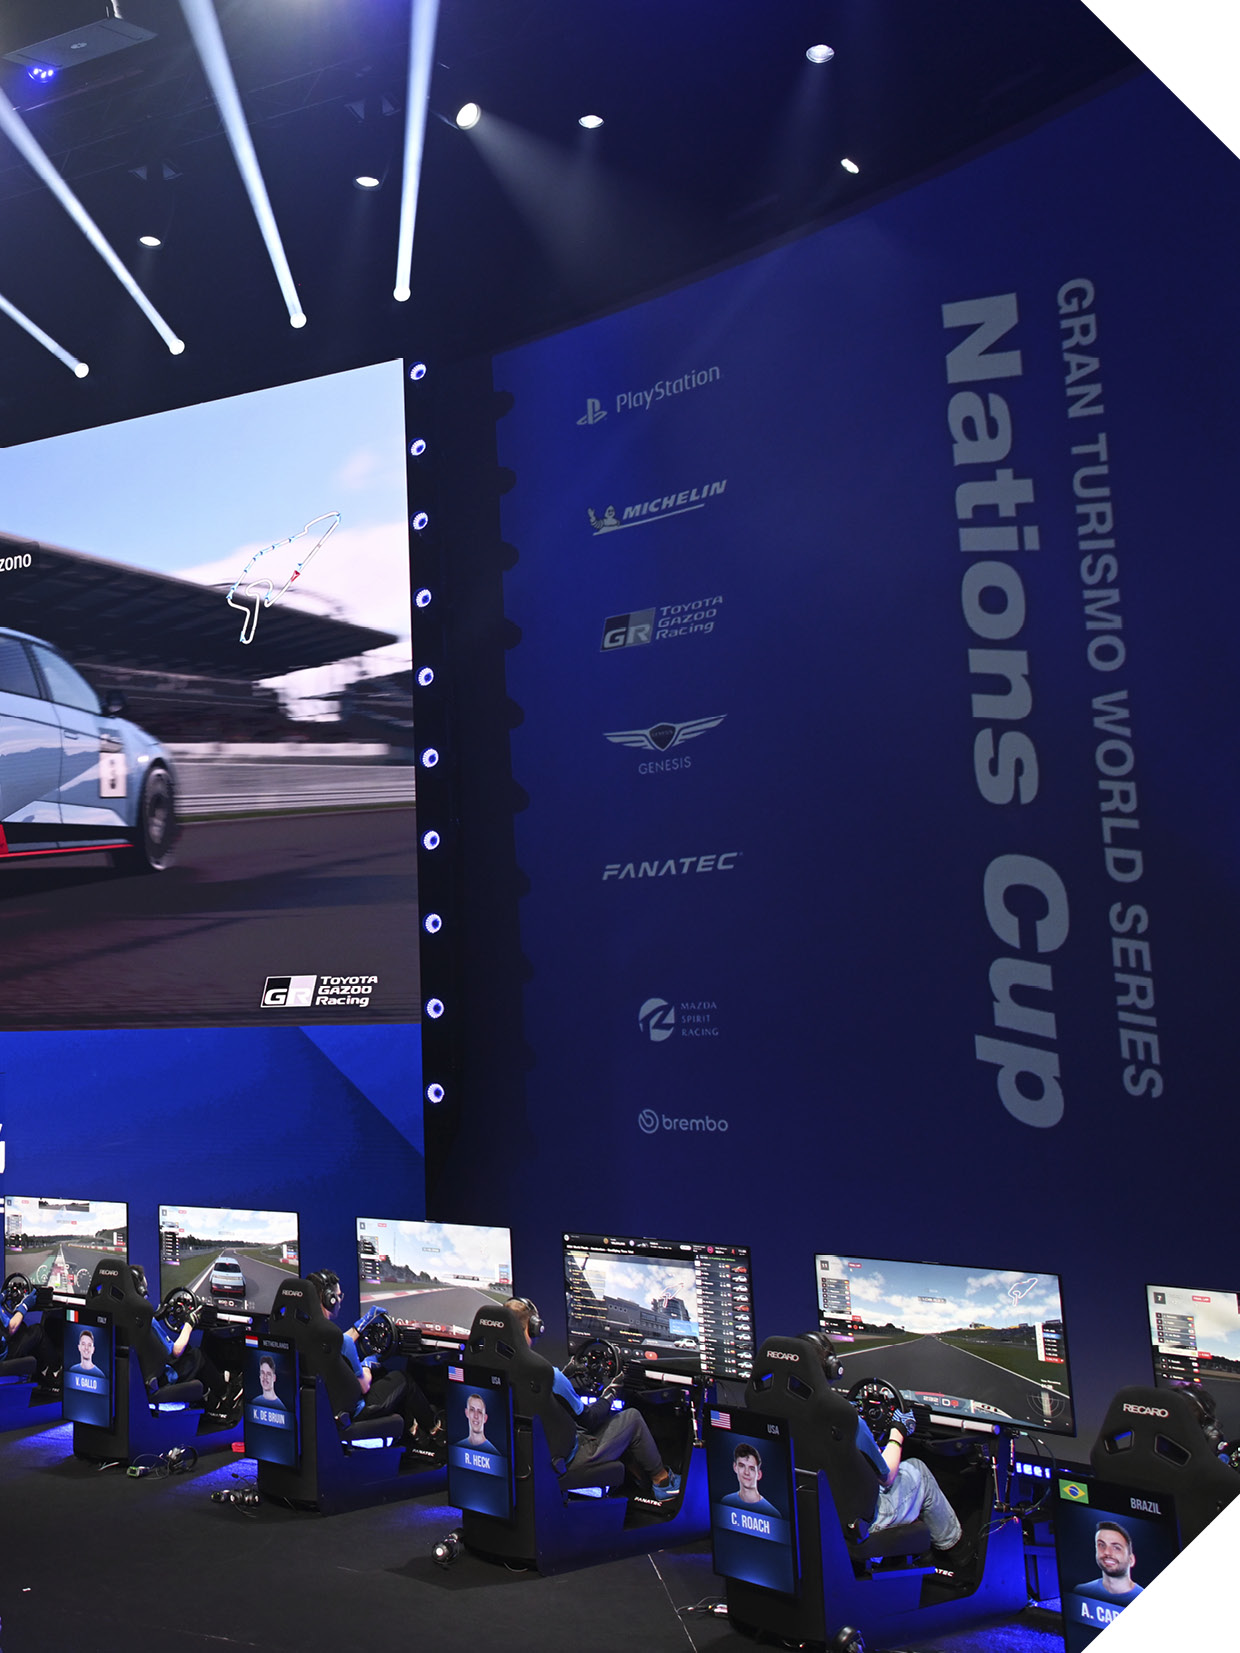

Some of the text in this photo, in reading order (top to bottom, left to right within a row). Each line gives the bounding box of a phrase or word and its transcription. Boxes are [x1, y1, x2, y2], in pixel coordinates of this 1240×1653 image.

[616, 365, 720, 413] PlayStation
[622, 480, 728, 521] MICHELIN
[659, 595, 723, 616] TOYOTA
[657, 608, 717, 628] GAZOO
[602, 624, 651, 649] GR
[655, 621, 715, 640] Racing
[1056, 277, 1163, 1098] GRAN TURISMO WORLD SERIES
[941, 292, 1069, 1129] Nations Cup
[638, 756, 692, 775] GENESIS
[602, 852, 738, 881] FANATEC
[320, 975, 378, 986] TOYOTA
[318, 985, 373, 995] GAZOO
[315, 995, 370, 1008] Racing
[680, 1001, 717, 1010] MAZDA
[681, 1014, 710, 1024] SPIRIT
[681, 1028, 719, 1037] RACING
[662, 1114, 729, 1132] brembo
[479, 1319, 504, 1329] RECARO
[766, 1350, 800, 1362] RECARO
[1122, 1403, 1169, 1418] RECARO
[767, 1424, 780, 1435] USA
[464, 1453, 491, 1469] R. HECK
[1130, 1497, 1162, 1515] BRAZIL
[731, 1511, 770, 1534] C. ROACH
[1081, 1602, 1094, 1619] A.
